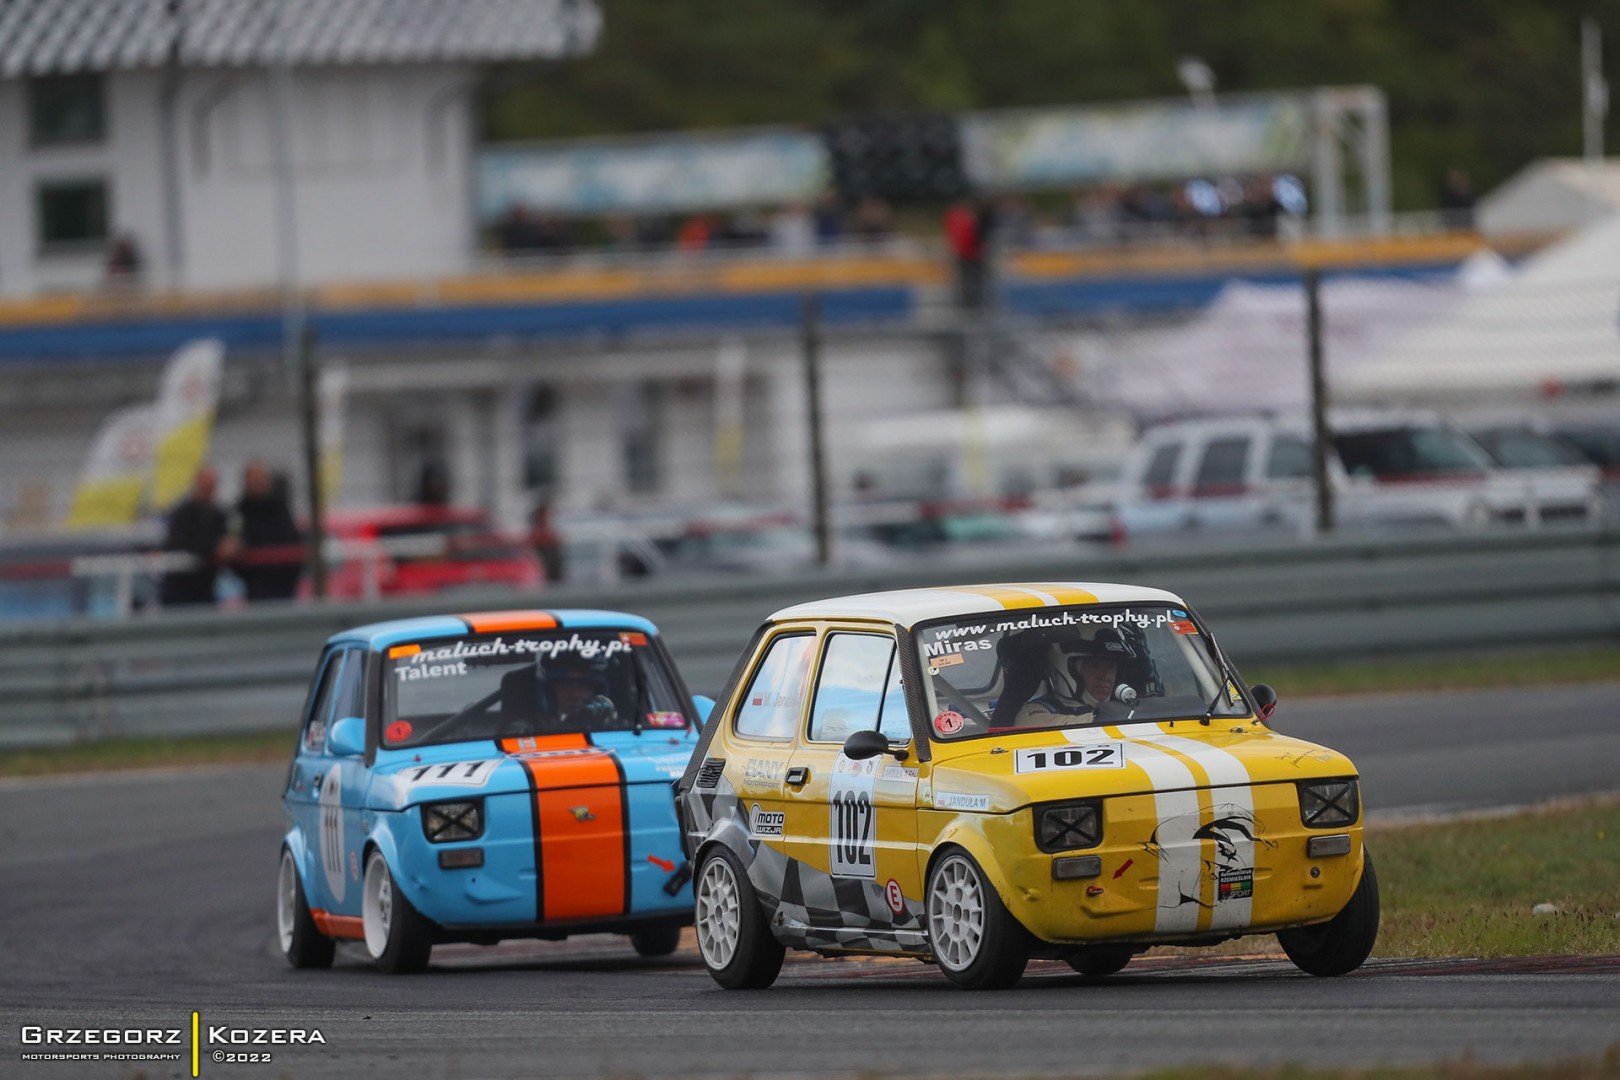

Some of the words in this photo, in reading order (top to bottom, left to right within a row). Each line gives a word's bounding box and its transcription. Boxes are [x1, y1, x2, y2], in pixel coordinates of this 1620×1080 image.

[923, 636, 993, 657] Miras
[394, 660, 468, 682] Talent
[945, 718, 953, 728] 1
[1027, 749, 1115, 769] 102
[411, 760, 486, 782] 111
[757, 813, 785, 824] MOTO
[833, 790, 872, 865] 102
[889, 885, 900, 906] E
